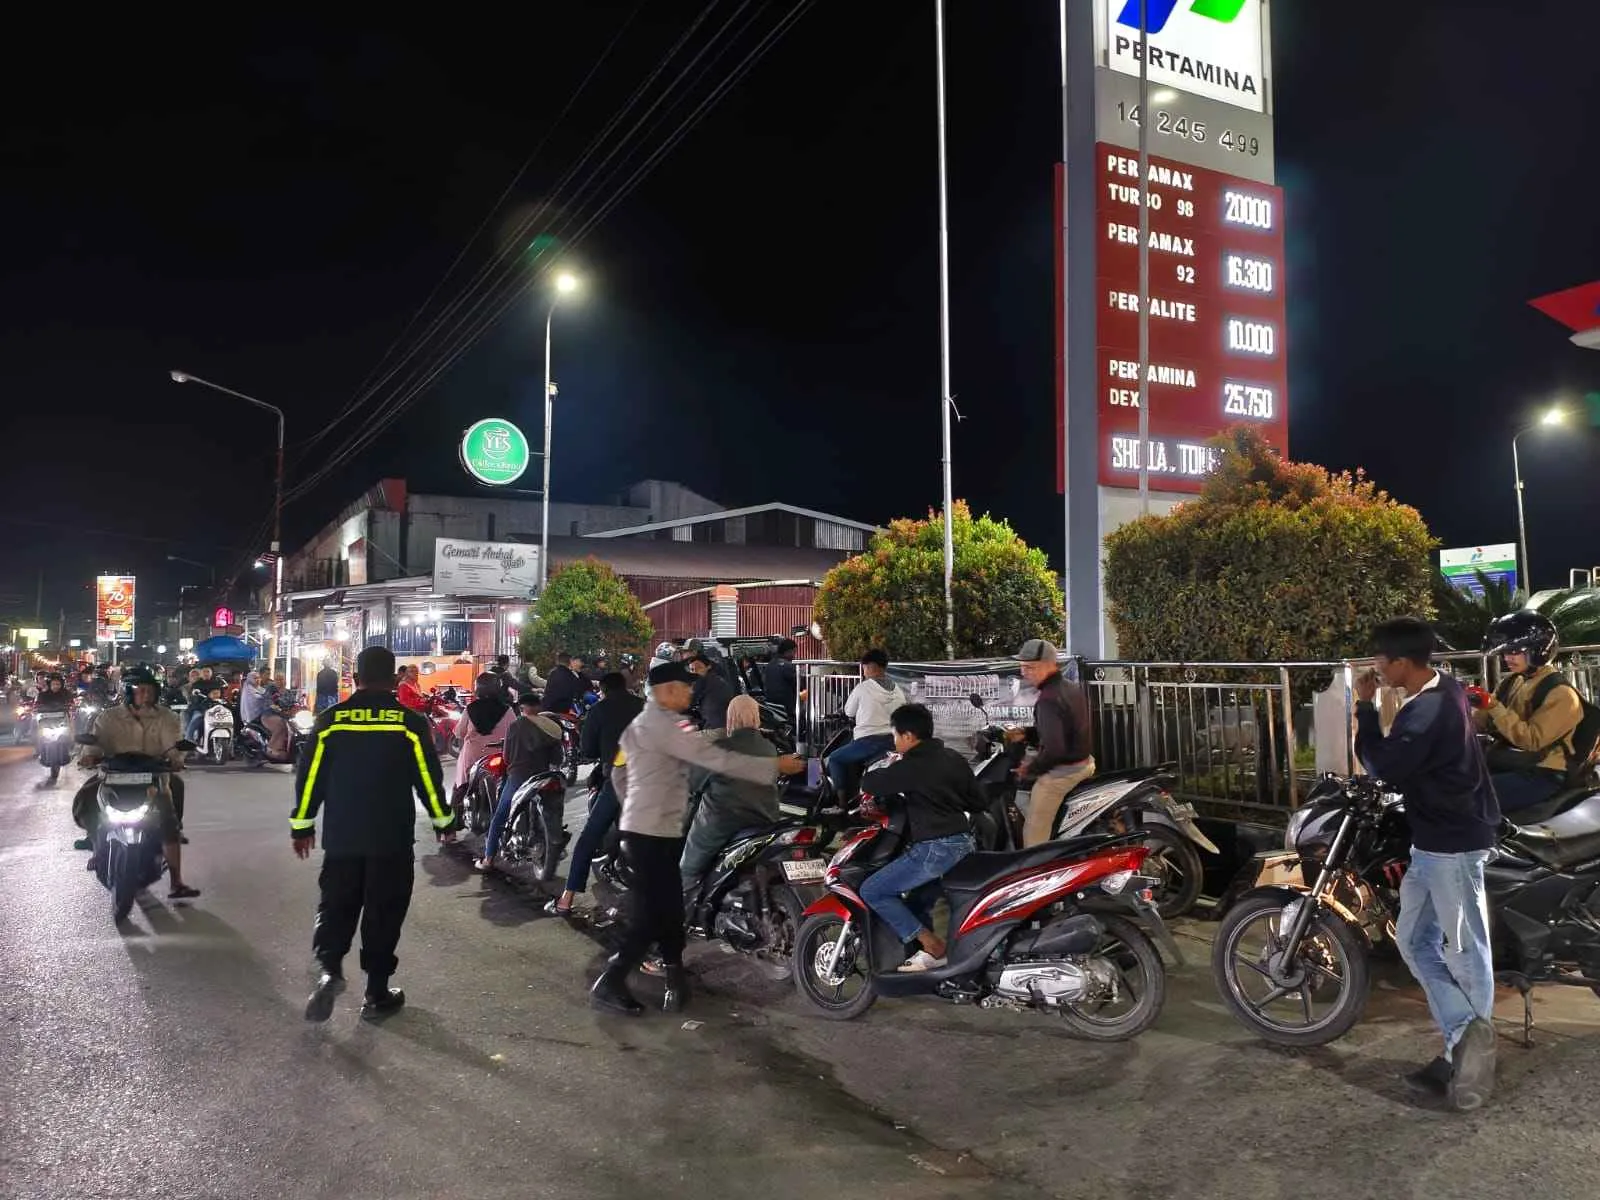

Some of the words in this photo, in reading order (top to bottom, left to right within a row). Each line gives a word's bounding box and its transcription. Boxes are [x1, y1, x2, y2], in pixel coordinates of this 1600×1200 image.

[1115, 35, 1257, 95] PERTAMINA
[1157, 112, 1207, 143] 245
[1219, 130, 1259, 156] 499
[1107, 155, 1193, 190] PERAMAX
[1177, 199, 1194, 217] 98
[1108, 223, 1195, 256] PERAMAX
[1176, 265, 1195, 284] 92
[1109, 291, 1196, 322] PERALITE
[1229, 320, 1273, 354] 10.000
[1109, 360, 1196, 388] PERAMINA
[1109, 388, 1141, 407] DEX
[335, 709, 404, 722] POLISI
